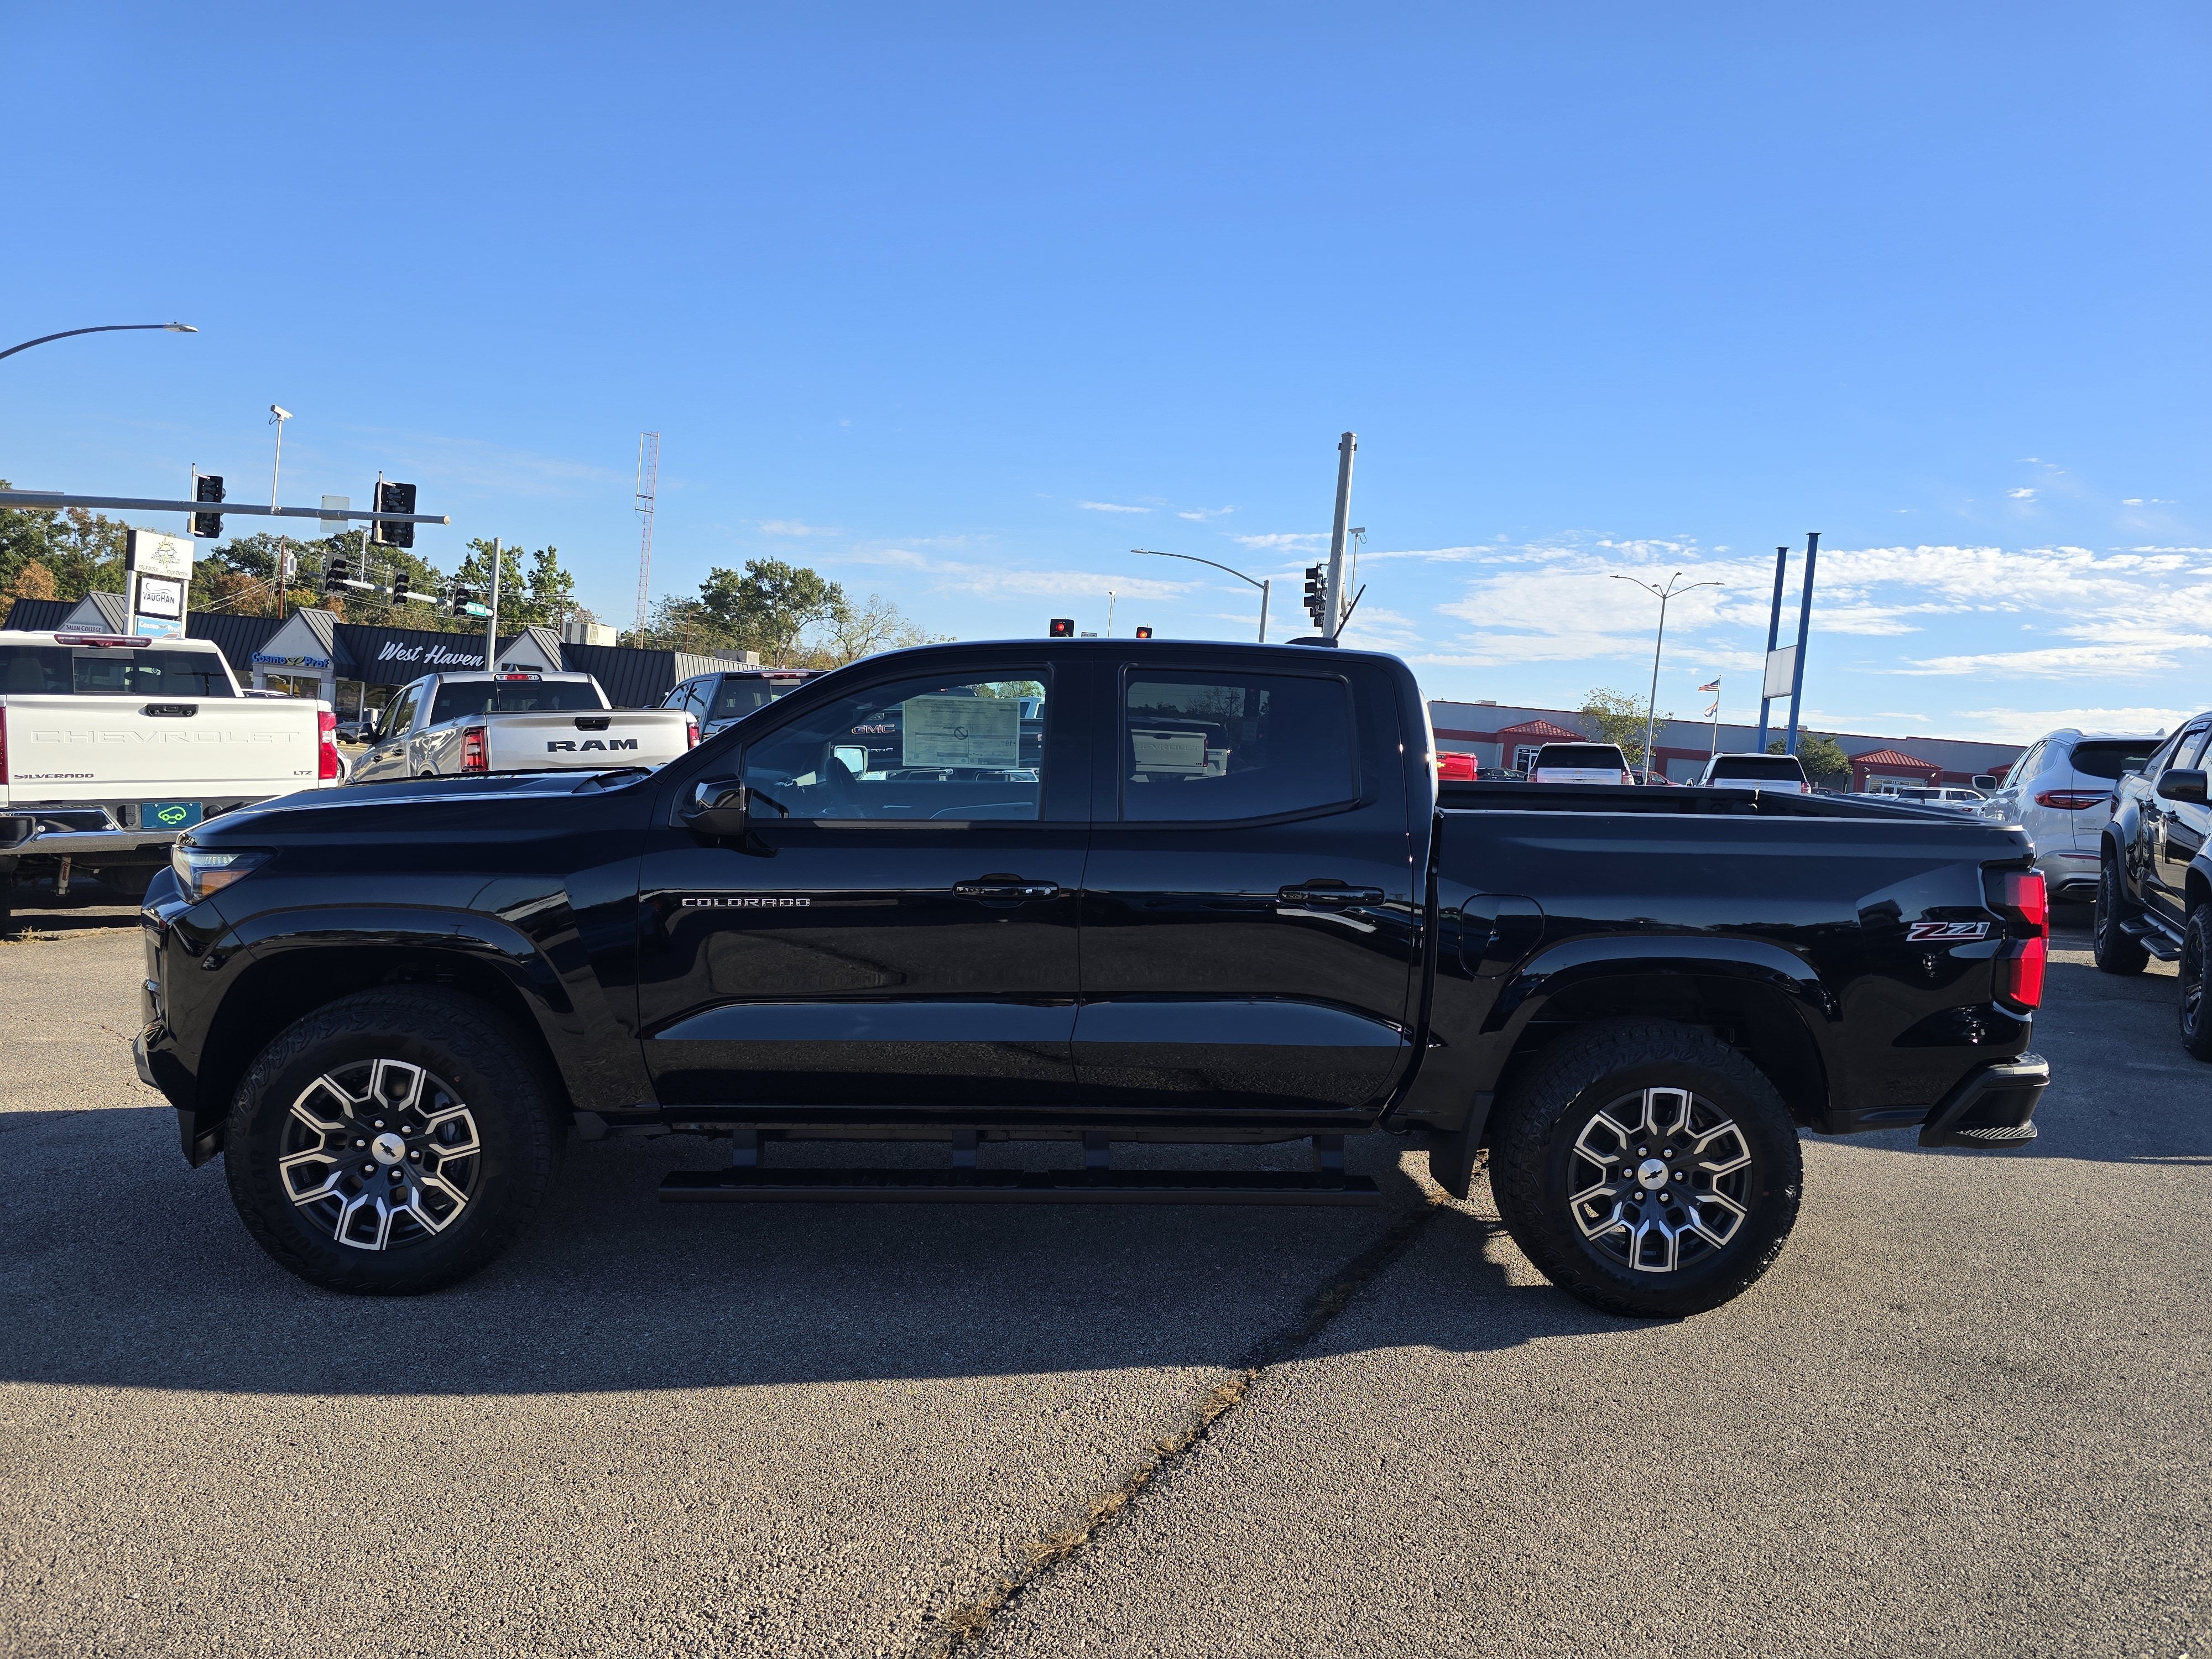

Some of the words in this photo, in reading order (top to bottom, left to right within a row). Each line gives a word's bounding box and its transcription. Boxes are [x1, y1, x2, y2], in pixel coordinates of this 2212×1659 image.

[143, 592, 175, 604] VAUGHAN
[139, 620, 159, 629] Cosmo
[168, 624, 180, 633] Prof
[252, 651, 286, 664] Cosmo
[304, 656, 331, 668] Prof
[378, 641, 424, 661] West
[423, 645, 484, 667] Haven
[851, 724, 895, 734] GMC
[30, 730, 299, 744] CHEVROLET
[547, 739, 638, 752] RAM
[682, 898, 811, 907] COLORADO
[1906, 922, 1991, 941] Z71
